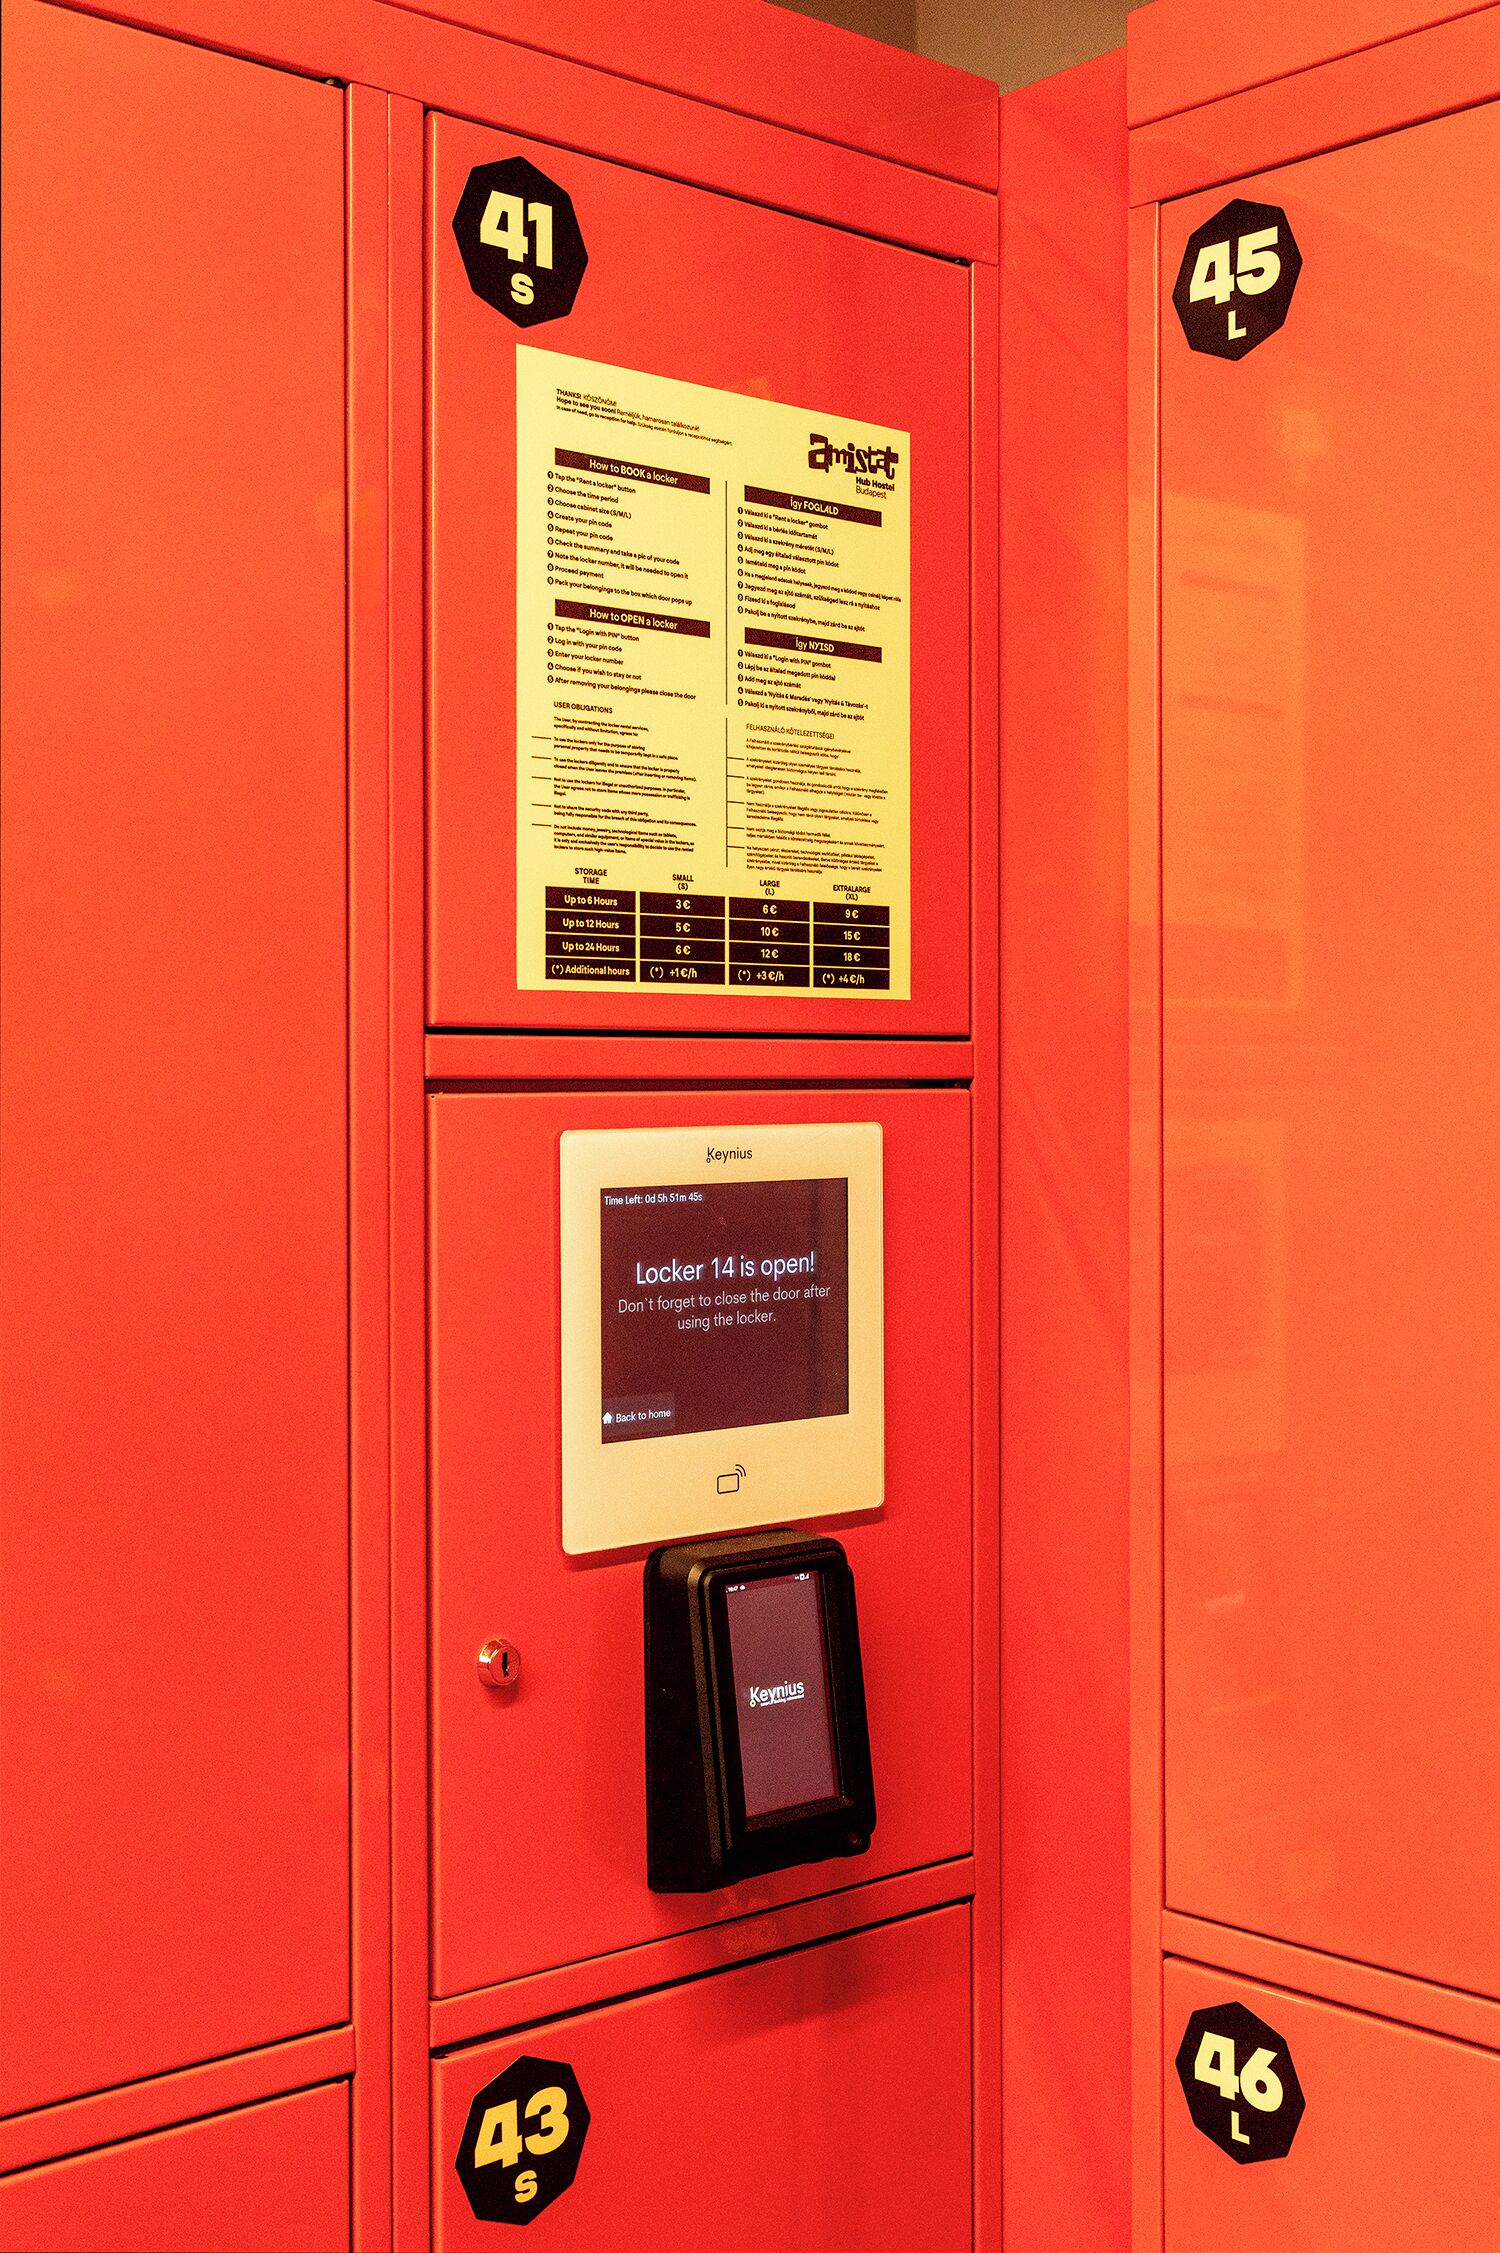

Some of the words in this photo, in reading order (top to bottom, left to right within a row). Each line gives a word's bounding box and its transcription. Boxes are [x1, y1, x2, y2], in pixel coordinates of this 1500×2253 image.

[479, 189, 552, 269] 41
[1189, 225, 1280, 304] 45
[510, 272, 534, 305] S
[1228, 310, 1246, 340] L
[807, 432, 898, 480] amistat
[589, 458, 609, 471] How
[610, 463, 619, 473] to
[620, 464, 645, 478] BOOK
[653, 471, 678, 484] locker
[554, 472, 565, 481] Tap
[617, 484, 635, 493] button
[855, 476, 870, 486] Hub
[871, 479, 894, 491] Hostel
[554, 486, 576, 495] Choose
[586, 492, 599, 500] time
[600, 495, 618, 503] period
[855, 484, 886, 499] Budapest
[554, 499, 576, 508] Choose
[576, 504, 598, 512] cabinet
[609, 509, 631, 519] (S/M/L)
[803, 500, 839, 515] FOGLALD
[554, 512, 574, 521] Create
[554, 525, 575, 534] Repeat
[554, 565, 578, 574] Proceed
[579, 570, 603, 578] payment
[589, 608, 609, 619] How
[610, 612, 619, 621] to
[620, 613, 644, 625] OPEN
[645, 618, 651, 626] a
[652, 617, 677, 629] locker
[554, 637, 565, 646] Log
[808, 640, 834, 652] NYISD
[584, 654, 601, 662] locker
[553, 701, 570, 709] USER
[570, 703, 613, 714] OBLIGATIONS
[574, 867, 607, 878] STORAGE
[672, 873, 694, 882] SMALL
[582, 876, 599, 884] TIME
[759, 879, 780, 887] LARGE
[677, 882, 688, 891] (S)
[764, 887, 775, 896] (L)
[832, 884, 870, 895] EXTRALARGE
[564, 894, 576, 906] Up
[576, 895, 586, 904] to
[587, 895, 592, 904] 6
[593, 896, 617, 906] Hours
[845, 892, 858, 901] (XL)
[675, 899, 681, 909] 3
[682, 899, 690, 909] €
[762, 904, 768, 914] 6
[769, 904, 777, 914] €
[845, 908, 850, 918] 9
[851, 909, 858, 918] €
[562, 918, 575, 929] Up
[575, 919, 584, 927] to
[585, 919, 594, 928] 12
[595, 919, 619, 929] Hours
[675, 922, 681, 932] 5
[682, 922, 690, 932] €
[760, 926, 770, 936] 10
[771, 927, 779, 936] €
[843, 930, 852, 940] 15
[853, 931, 860, 940] €
[562, 941, 574, 952] Up
[575, 942, 584, 950] to
[585, 942, 595, 951] 24
[595, 942, 620, 952] Hours
[675, 944, 681, 954] 6
[682, 945, 690, 955] €
[760, 948, 770, 958] 12
[771, 948, 778, 958] €
[843, 952, 852, 961] 18
[853, 952, 860, 962] €
[564, 964, 606, 974] Additional
[607, 965, 630, 975] hours
[669, 967, 679, 977] +1
[680, 967, 697, 979] €/h
[756, 970, 766, 980] +3
[767, 970, 784, 982] €/h
[838, 974, 848, 983] +4
[849, 974, 864, 985] €/h
[706, 1146, 752, 1164] Keynius
[604, 1195, 623, 1205] Time
[625, 1193, 643, 1204] Left:
[644, 1193, 656, 1203] 0d
[657, 1193, 668, 1203] 5h
[669, 1192, 686, 1202] 51m
[688, 1191, 702, 1201] 45s
[636, 1258, 703, 1284] Locker
[711, 1256, 734, 1278] 14
[740, 1254, 754, 1277] is
[760, 1251, 814, 1281] open!
[656, 1294, 695, 1312] forget
[698, 1294, 711, 1306] to
[714, 1290, 747, 1305] close
[750, 1288, 769, 1302] the
[772, 1286, 800, 1300] door
[803, 1284, 830, 1298] after
[677, 1314, 710, 1331] using
[713, 1311, 733, 1326] the
[736, 1309, 776, 1324] locker.
[615, 1411, 636, 1423] Back
[637, 1411, 647, 1420] to
[648, 1409, 671, 1419] home
[749, 1681, 804, 1707] Keynius
[1194, 2031, 1283, 2112] 46
[474, 2086, 569, 2168] 43
[1230, 2110, 1249, 2144] L
[514, 2169, 537, 2202] S
